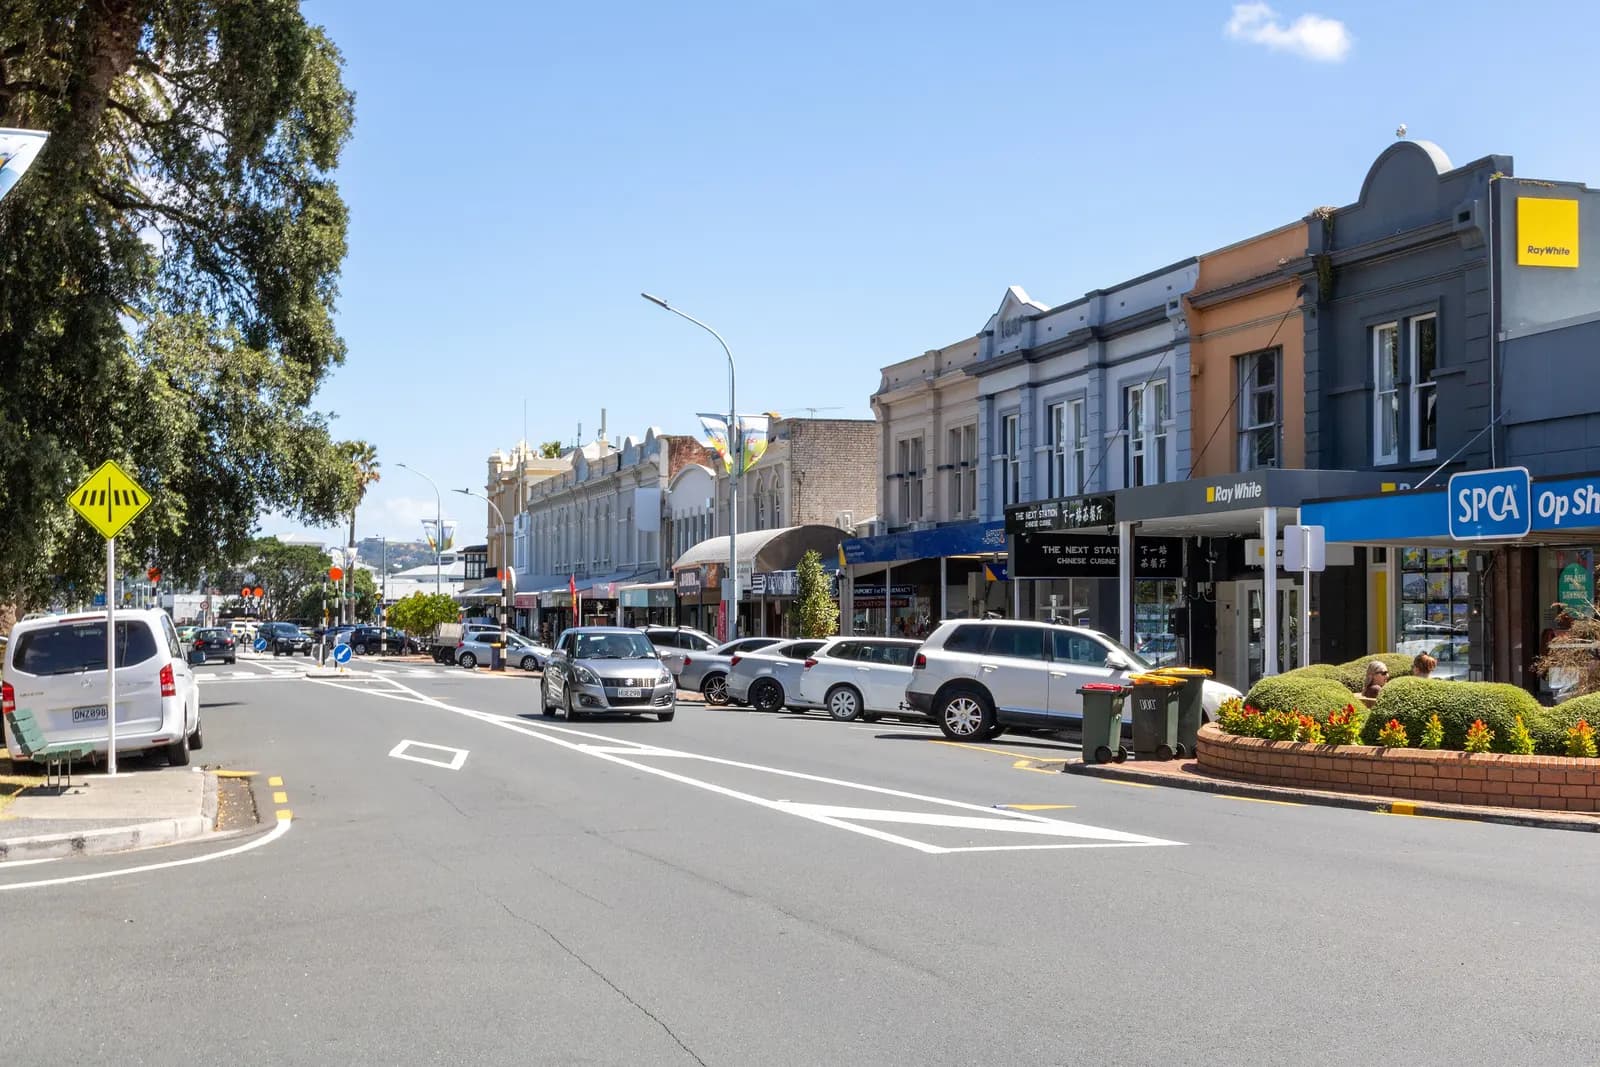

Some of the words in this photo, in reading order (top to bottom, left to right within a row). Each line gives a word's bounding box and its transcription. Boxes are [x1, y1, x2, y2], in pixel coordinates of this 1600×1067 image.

[1527, 245, 1544, 256] Ray
[1545, 246, 1570, 256] White
[1215, 485, 1234, 504] Ray
[1234, 481, 1262, 500] White
[1458, 484, 1520, 523] SPCA
[1538, 491, 1569, 525] Op
[1571, 484, 1600, 516] Sh
[1042, 545, 1061, 554] THE
[1065, 545, 1089, 554] NEXT
[1093, 545, 1120, 554] STATI
[1056, 557, 1087, 565] CHINESE
[1089, 557, 1117, 565] CUISINE
